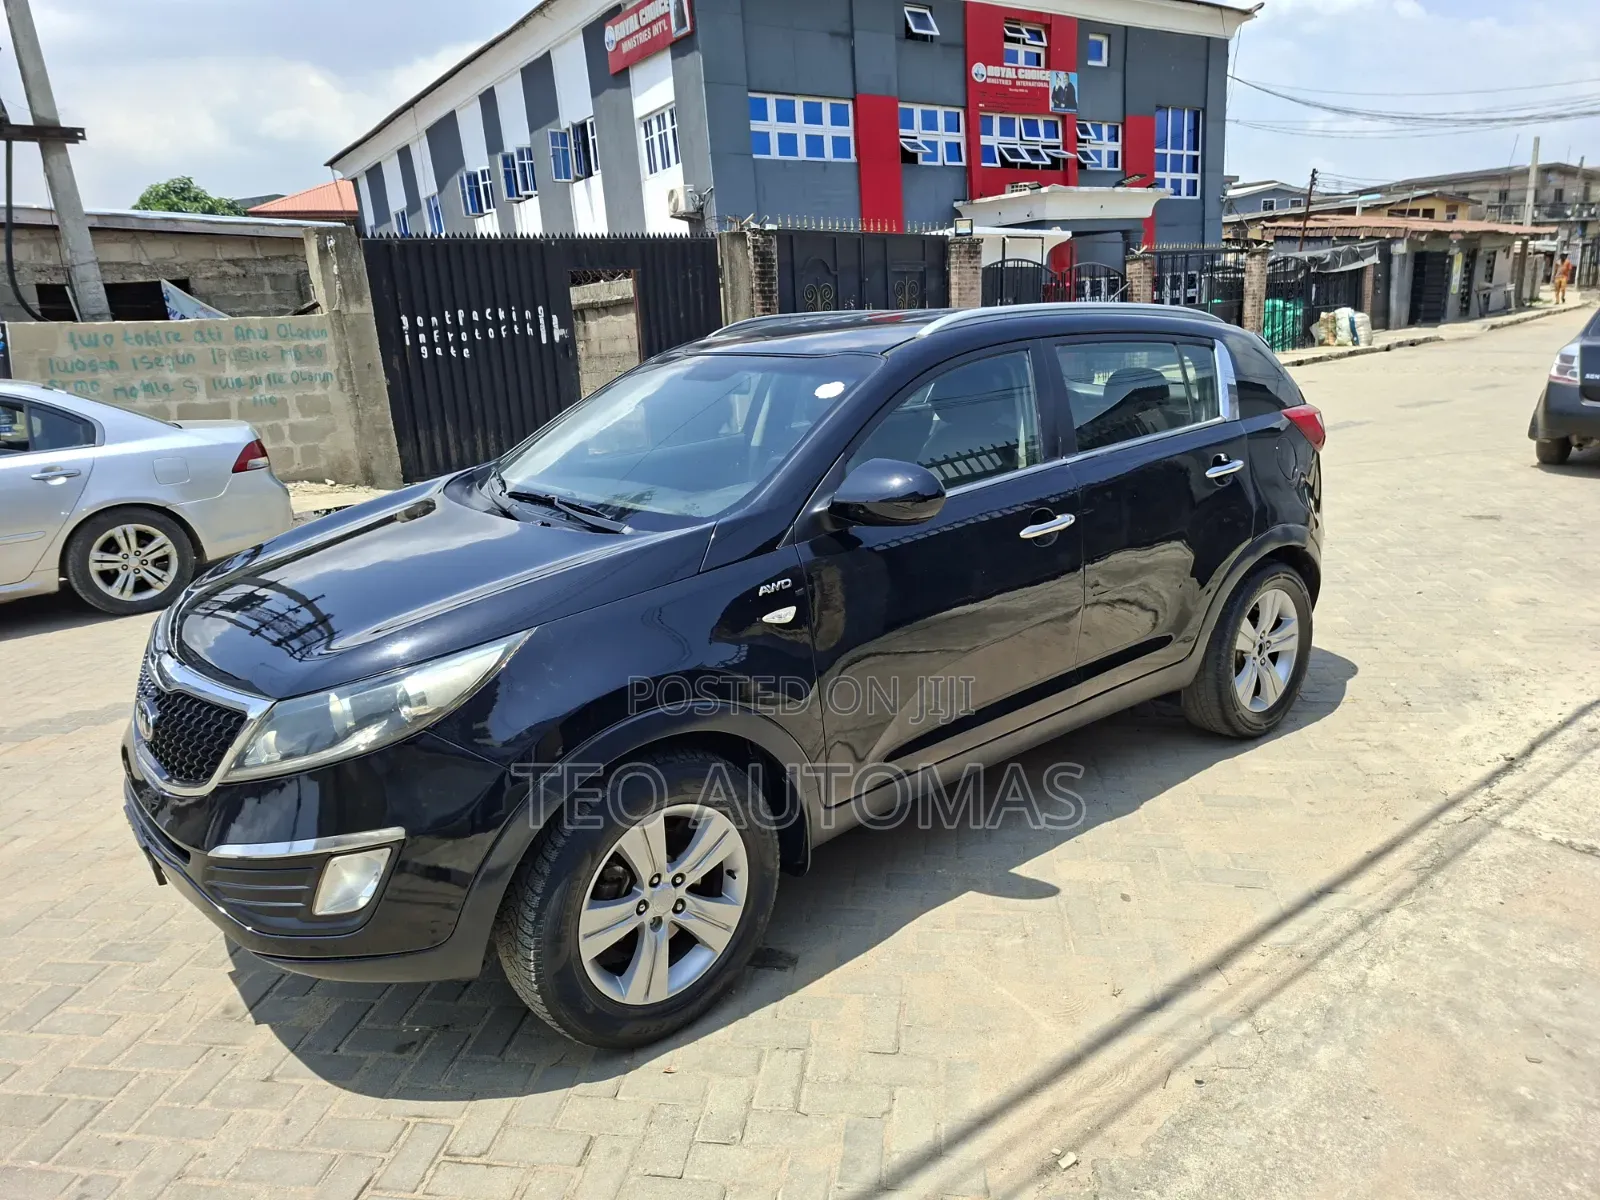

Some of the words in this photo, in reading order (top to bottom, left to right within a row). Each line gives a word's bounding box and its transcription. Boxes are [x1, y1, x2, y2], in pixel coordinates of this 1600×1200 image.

[621, 27, 652, 54] MINISTRIES
[987, 66, 1017, 78] ROYAL
[1016, 80, 1049, 88] INTERNATIONAL
[420, 345, 471, 359] gate
[758, 578, 792, 597] AWD
